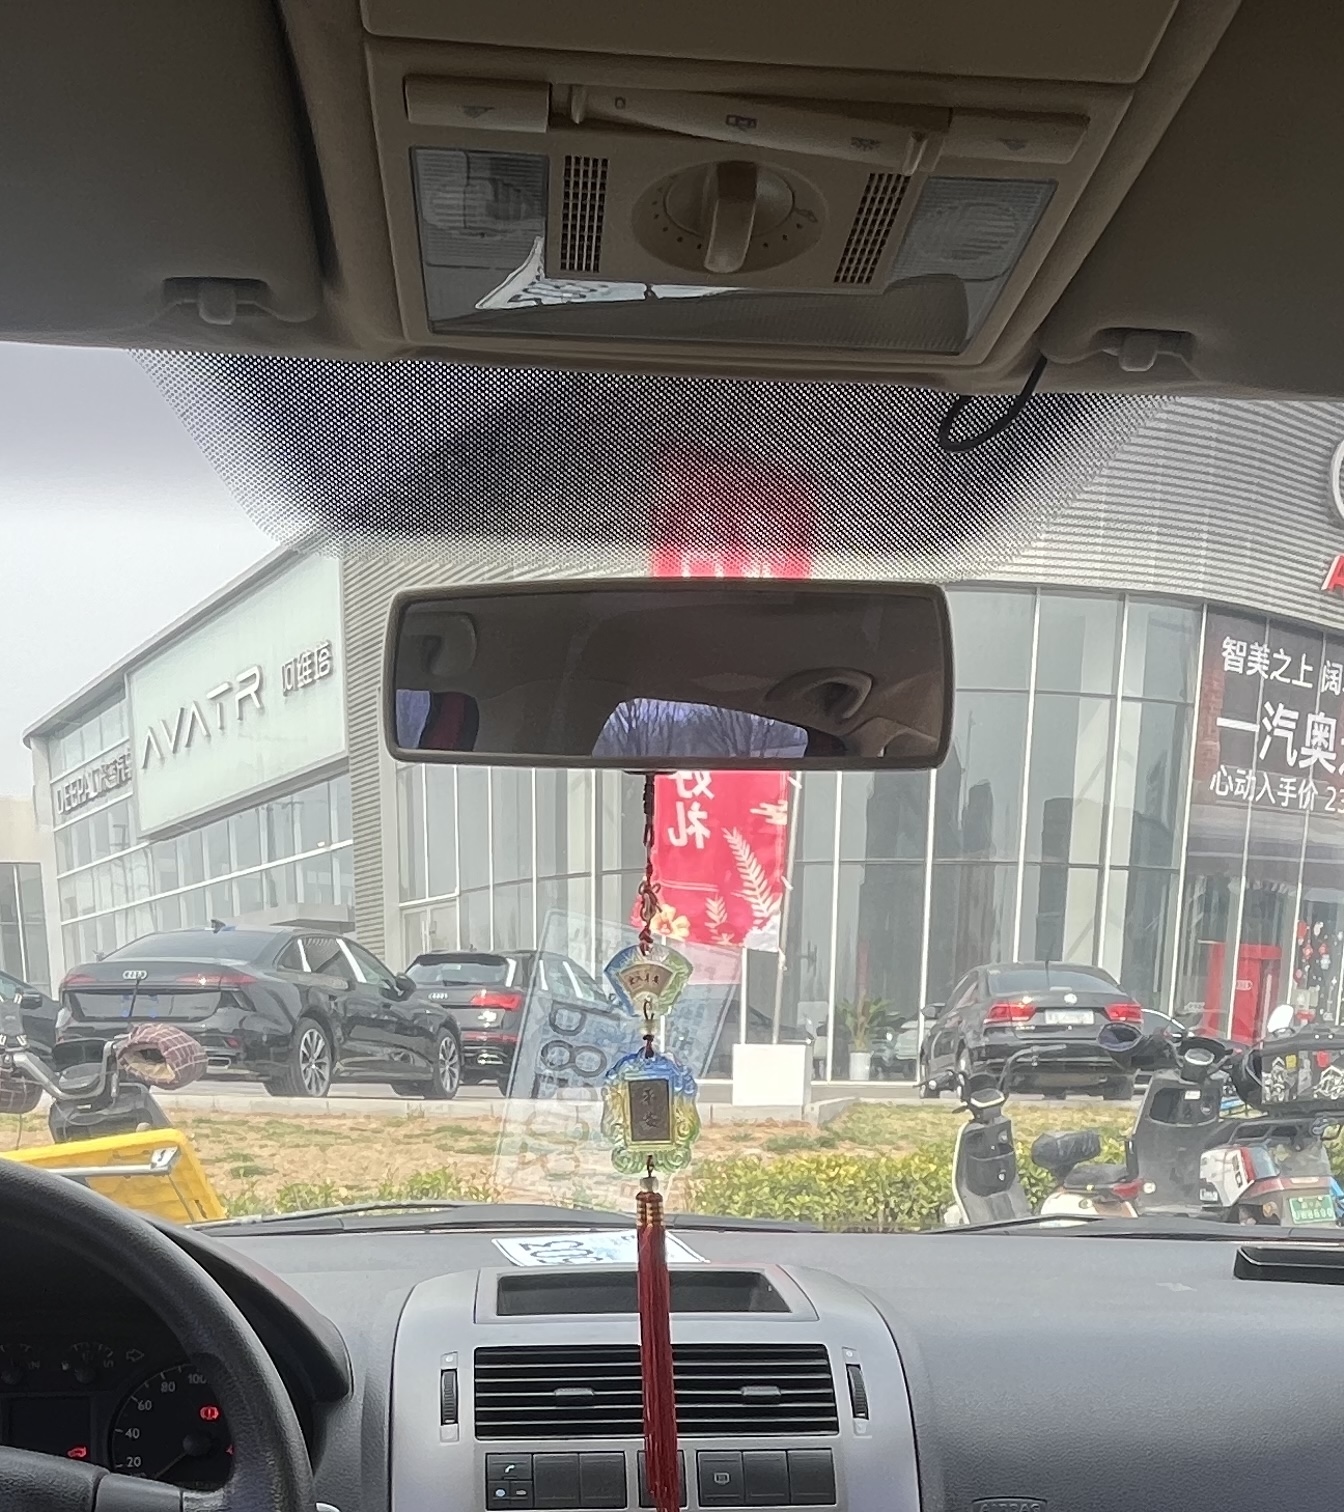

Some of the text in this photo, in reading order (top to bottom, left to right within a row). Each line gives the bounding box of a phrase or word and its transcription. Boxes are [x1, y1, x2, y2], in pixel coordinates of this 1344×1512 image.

[1221, 637, 1314, 689] 智美之上
[141, 665, 262, 769] AVATR
[1209, 766, 1318, 811] 心动入手价
[161, 1381, 176, 1393] 80
[137, 1399, 153, 1411] 60
[125, 1428, 140, 1439] 40
[126, 1456, 141, 1468] 20
